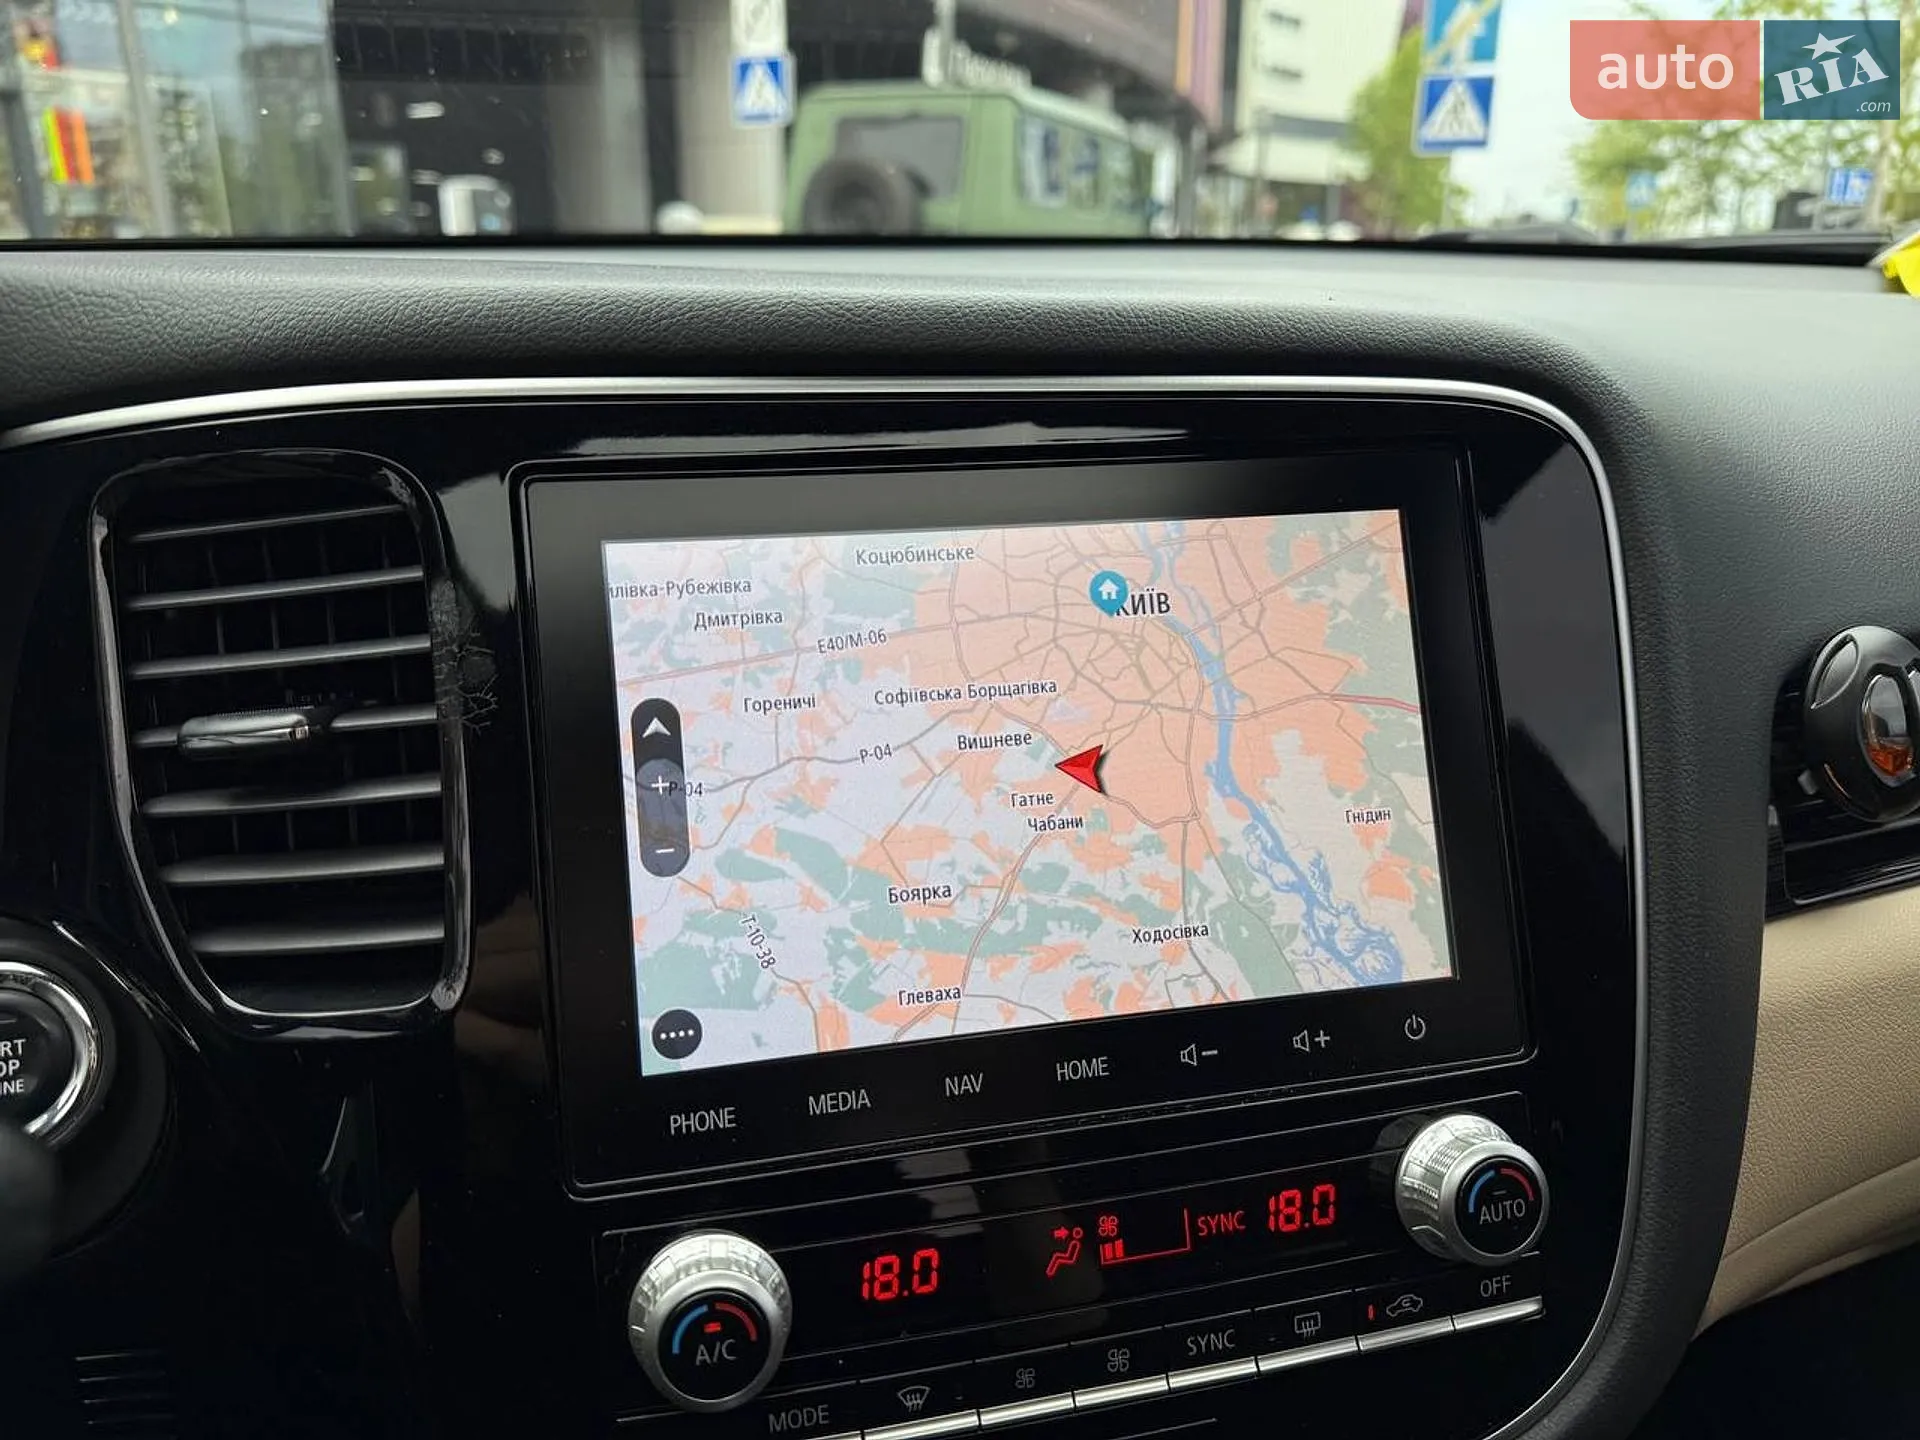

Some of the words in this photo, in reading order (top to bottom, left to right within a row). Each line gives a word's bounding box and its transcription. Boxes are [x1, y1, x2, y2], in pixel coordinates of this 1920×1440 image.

[856, 546, 975, 566] Коцюбинське
[694, 610, 783, 631] Дмитрівка
[743, 696, 816, 713] Гореничі
[874, 687, 962, 708] Софіївська
[967, 680, 1057, 700] Борщагівка
[957, 732, 1032, 751] Вишневе
[1011, 792, 1054, 808] Гатне
[1027, 813, 1084, 833] Чабани
[1345, 807, 1392, 825] Гнідин
[888, 883, 952, 904] Боярка
[1132, 923, 1210, 945] Ходосівка
[898, 986, 962, 1006] Глеваха
[1056, 1056, 1110, 1082] HOME
[945, 1073, 984, 1097] NAV
[808, 1088, 871, 1116] MEDIA
[669, 1107, 737, 1136] PHONE
[1268, 1184, 1335, 1232] 18.0
[1479, 1199, 1526, 1225] AUTO
[1198, 1210, 1246, 1237] SYNC
[862, 1248, 939, 1299] 18.0
[1480, 1275, 1512, 1298] OFF
[694, 1339, 737, 1366] A/C
[1187, 1329, 1236, 1356] SYNC
[768, 1404, 830, 1433] MODE
